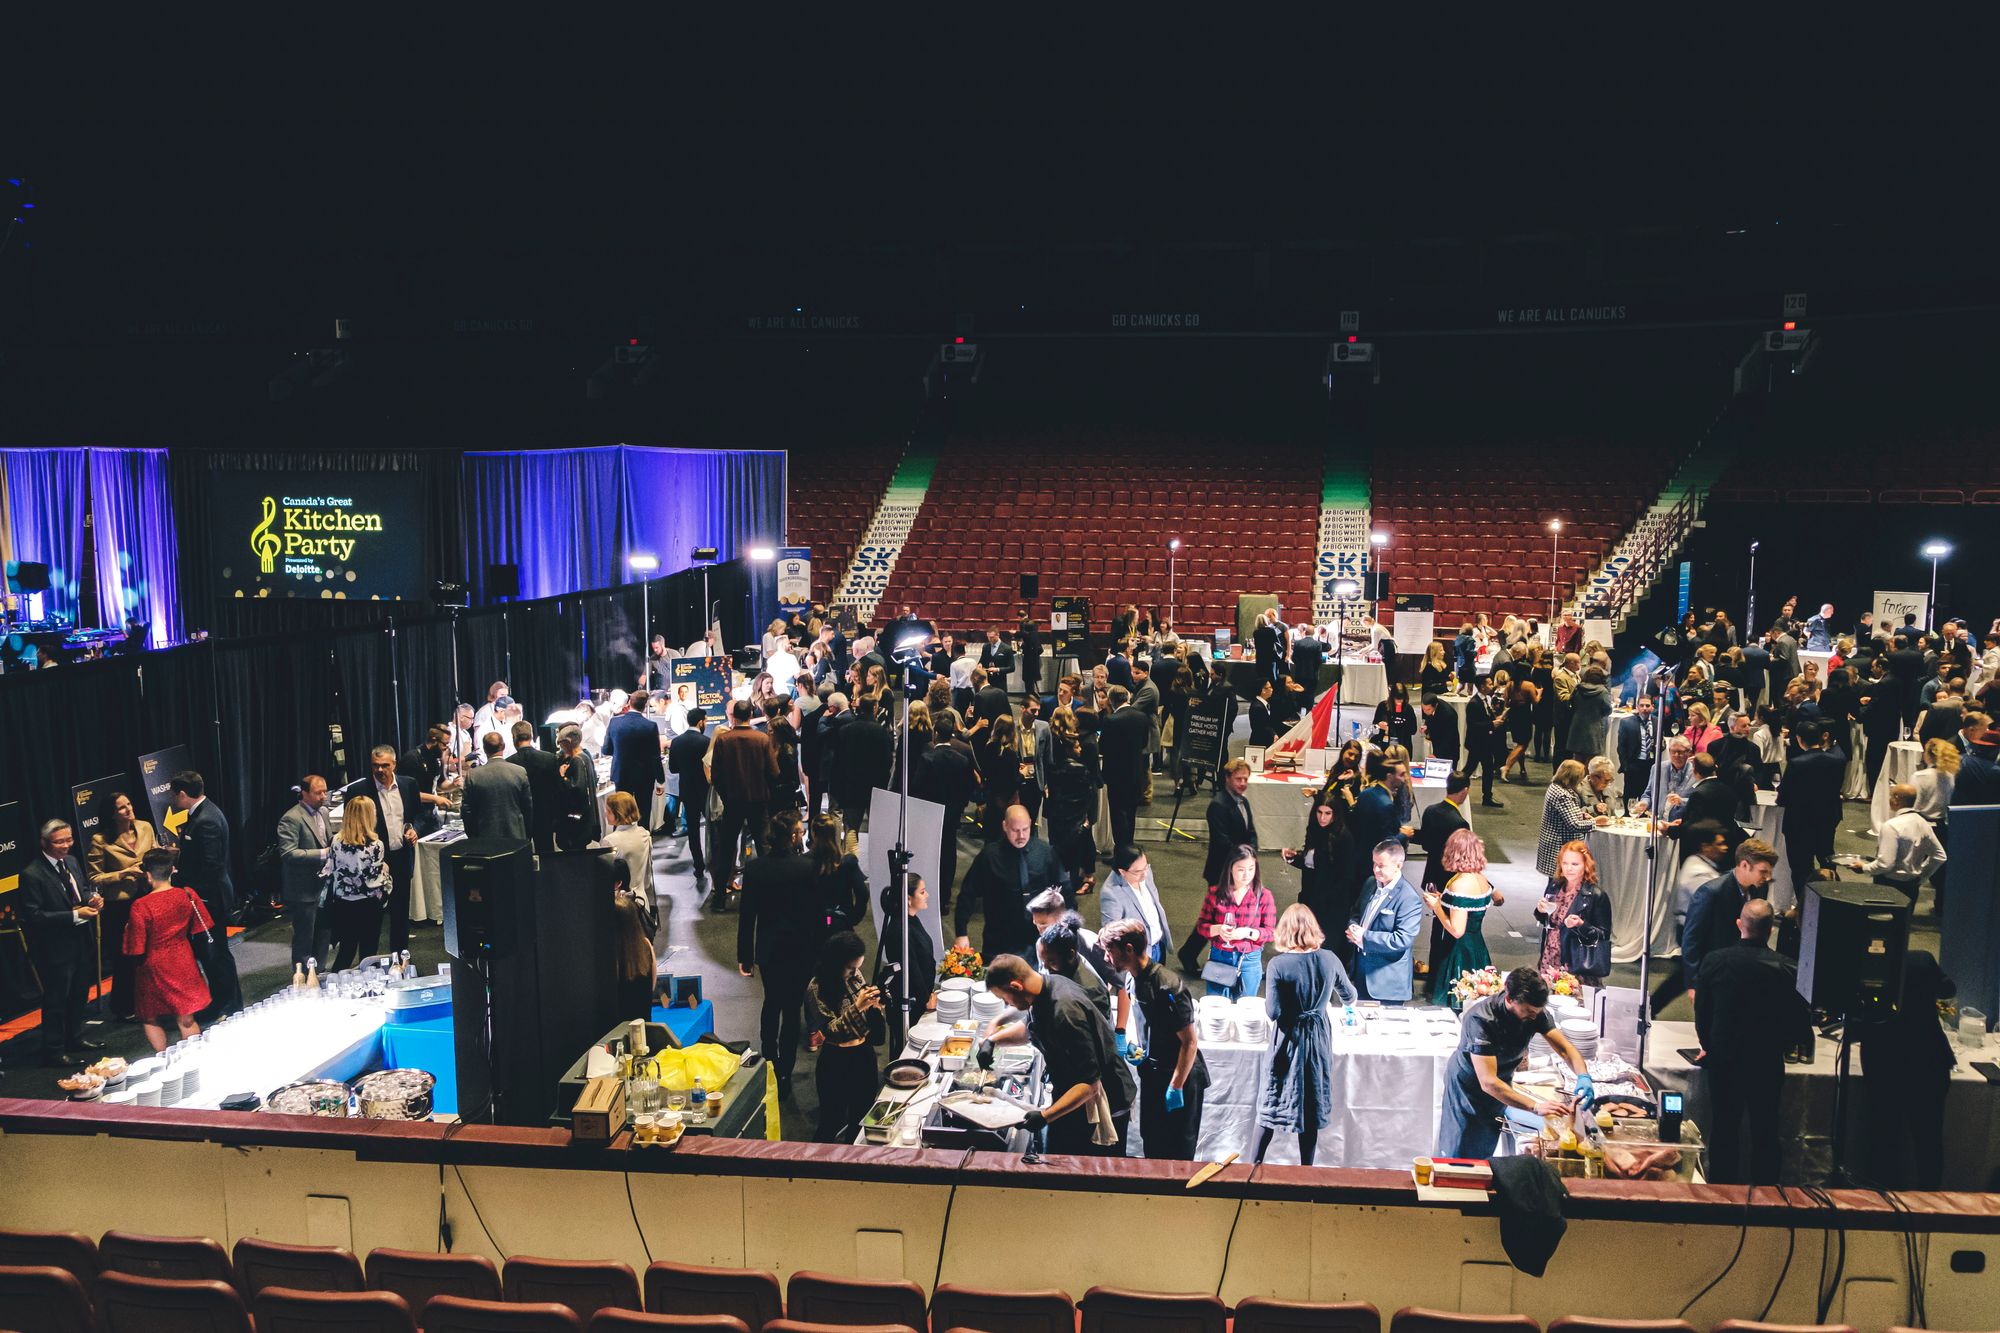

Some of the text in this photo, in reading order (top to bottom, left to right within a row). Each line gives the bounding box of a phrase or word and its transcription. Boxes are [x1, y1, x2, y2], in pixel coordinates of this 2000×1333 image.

[811, 316, 860, 328] CANUCKS
[1112, 314, 1200, 326] GO CANUCKS GO
[1498, 306, 1626, 322] WE ARE ALL CANUCKS
[282, 496, 352, 506] Canada's Great
[284, 508, 383, 531] Kitchen
[284, 533, 356, 561] Party
[1318, 552, 1368, 578] SKI
[1322, 579, 1362, 601] BG
[1316, 604, 1365, 617] WHTE
